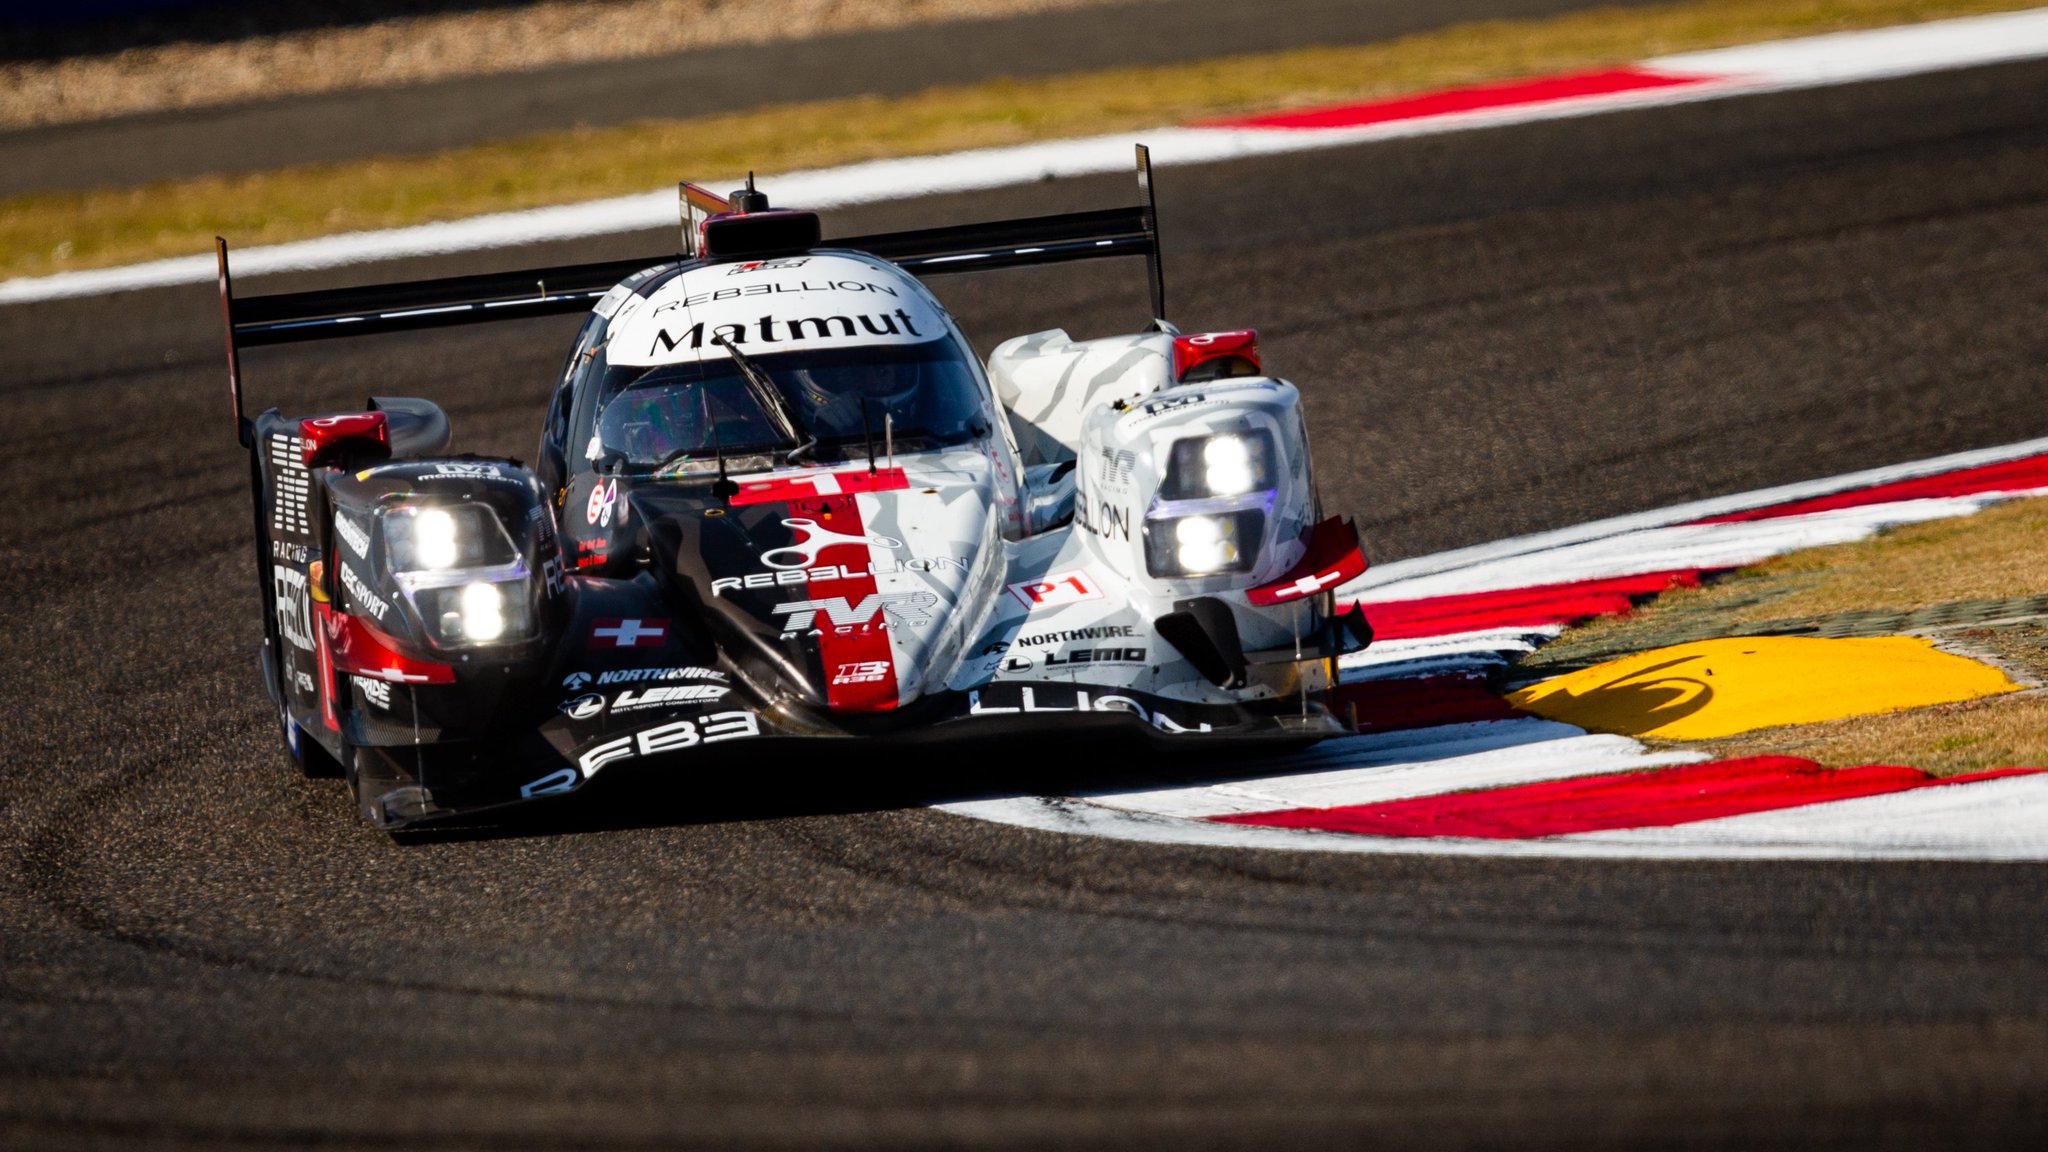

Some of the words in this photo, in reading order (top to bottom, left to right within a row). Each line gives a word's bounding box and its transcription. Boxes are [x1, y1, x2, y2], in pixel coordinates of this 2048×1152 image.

[649, 307, 923, 358] Matmut
[273, 540, 308, 565] RACING
[1020, 575, 1089, 603] P1
[771, 591, 938, 632] TVR
[779, 619, 928, 641] RACING
[1018, 625, 1135, 648] NORTHWIRE
[1045, 647, 1147, 666] LEMO
[596, 666, 730, 685] NORTHWIRE
[611, 684, 732, 708] LEMO
